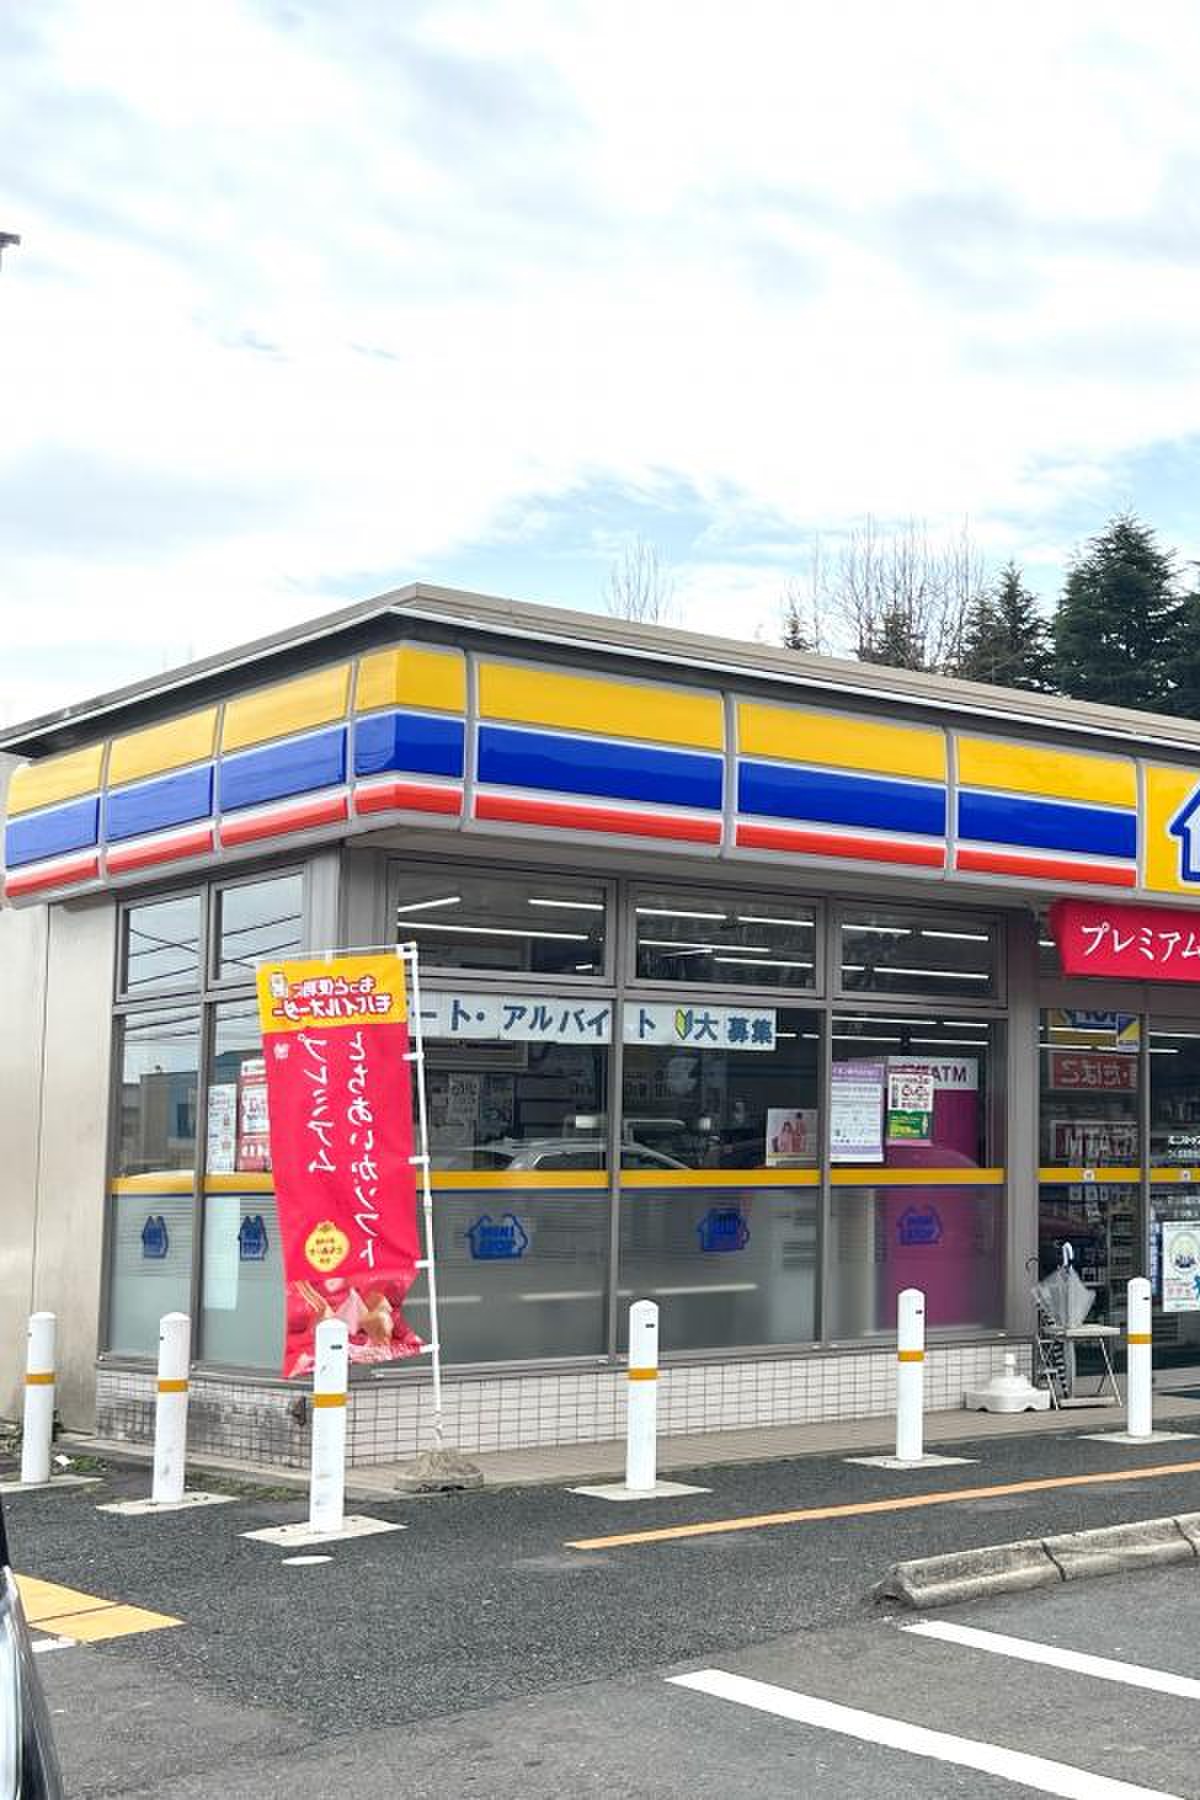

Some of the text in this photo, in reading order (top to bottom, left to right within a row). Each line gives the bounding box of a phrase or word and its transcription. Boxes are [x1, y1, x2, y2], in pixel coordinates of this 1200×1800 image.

[406, 997, 773, 1045] ート・アルバイト 大募集
[931, 1065, 968, 1083] ATM
